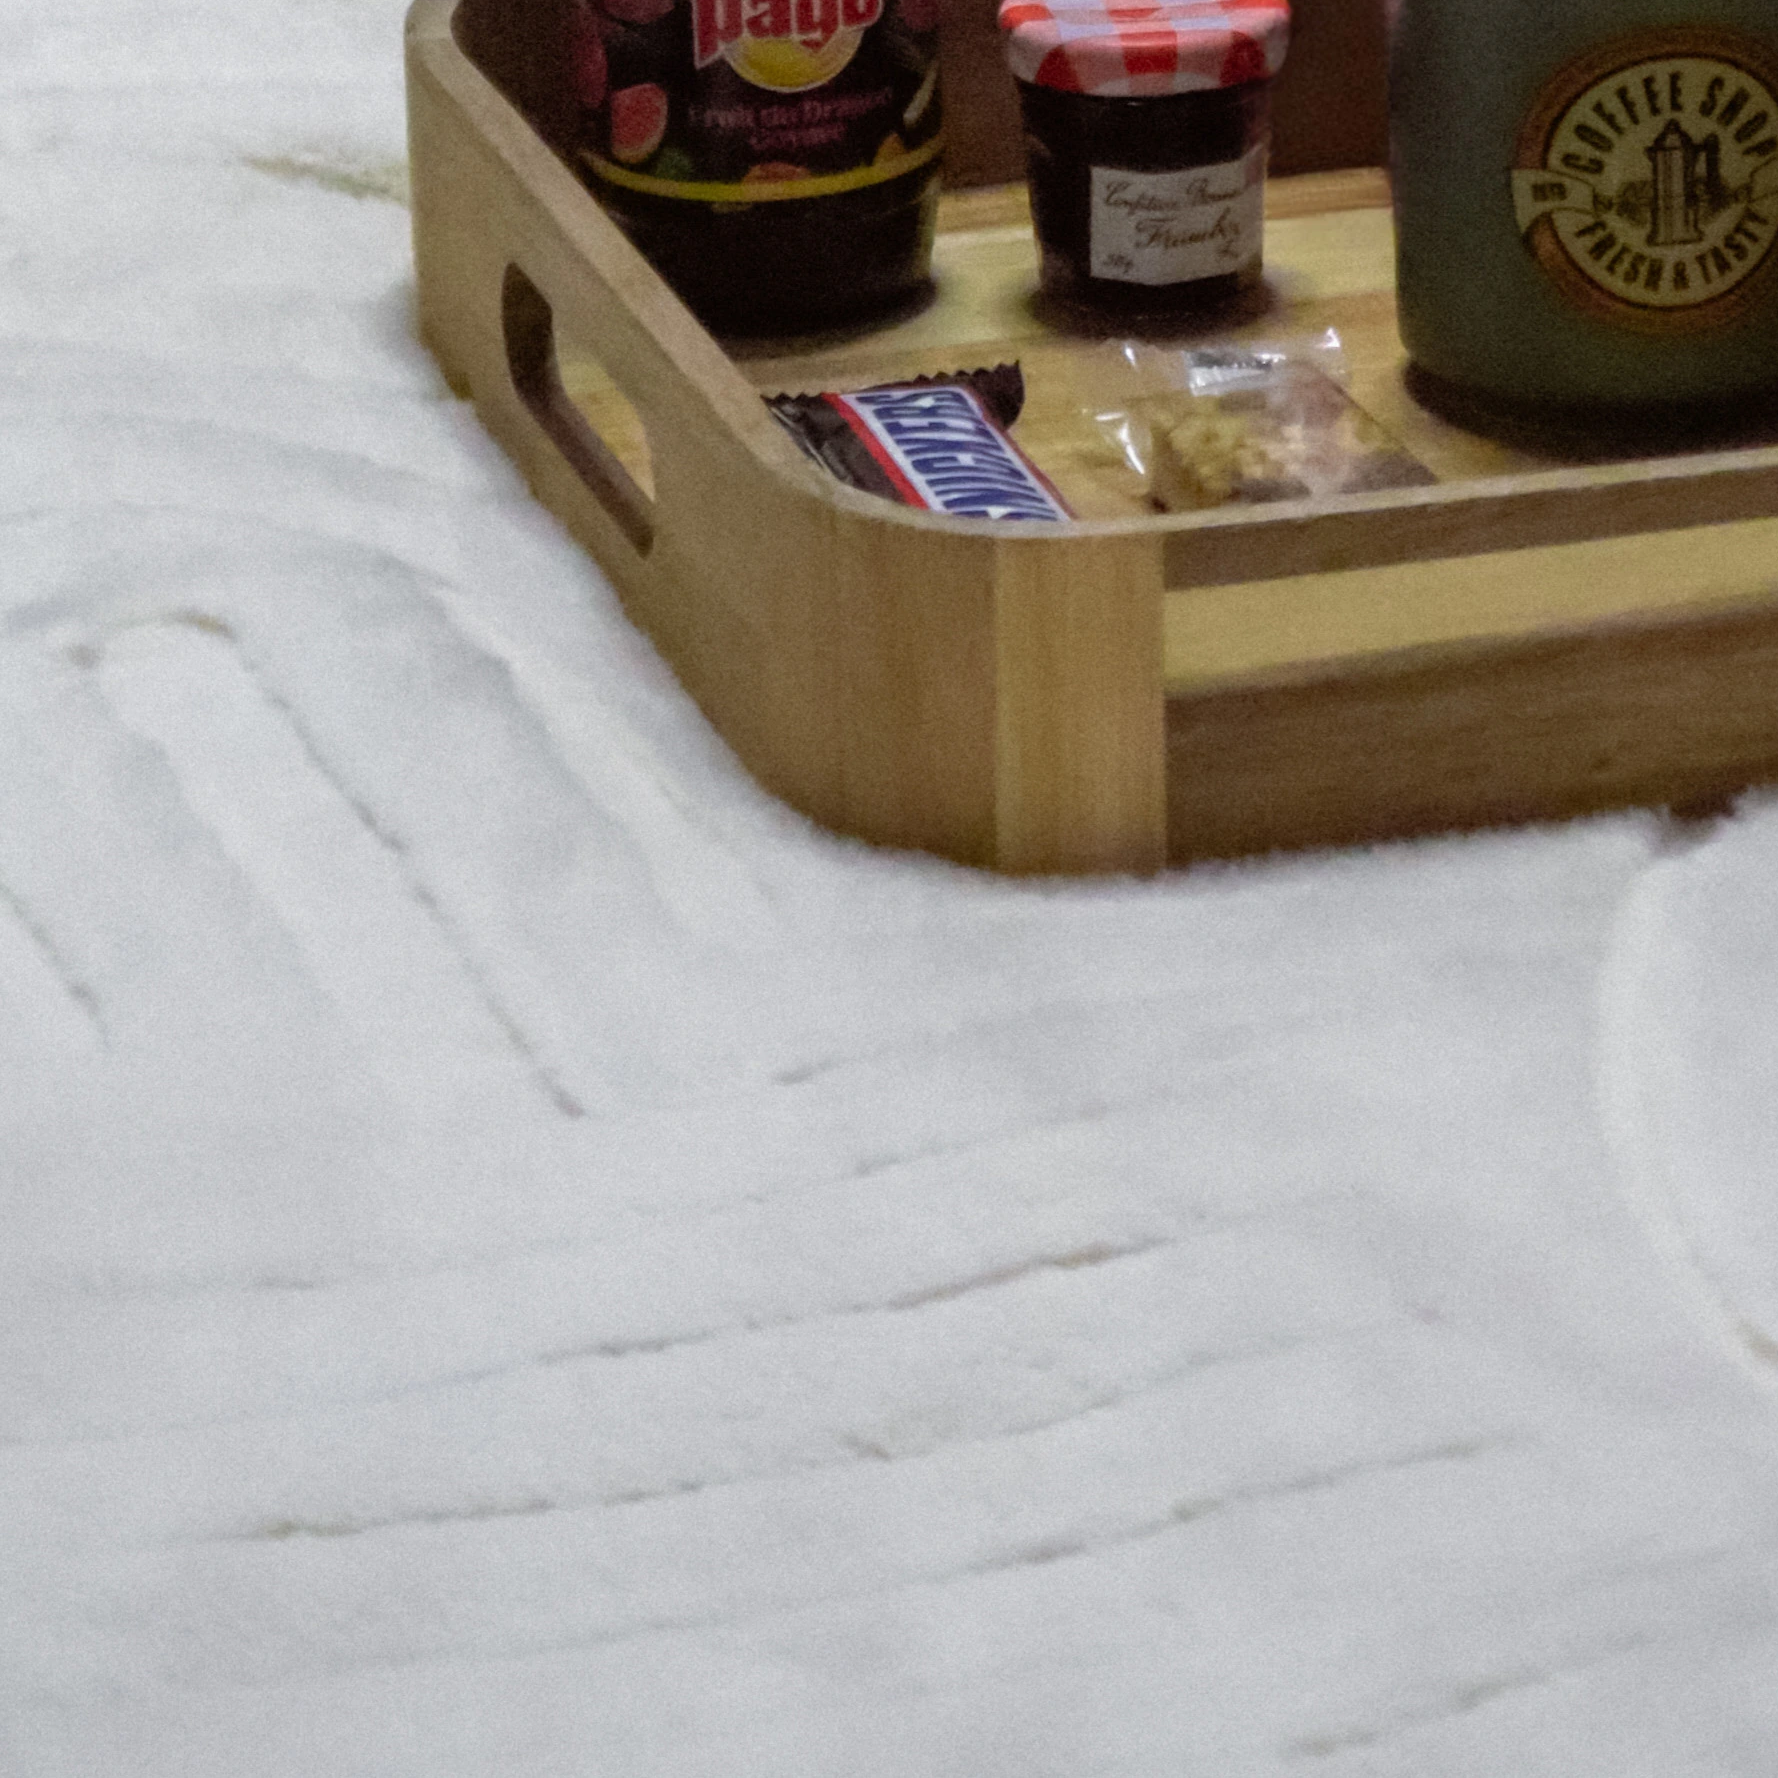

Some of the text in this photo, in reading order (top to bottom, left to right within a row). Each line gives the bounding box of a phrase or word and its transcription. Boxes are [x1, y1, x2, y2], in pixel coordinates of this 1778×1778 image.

[1560, 70, 1683, 175] COFFEE
[1573, 219, 1666, 292] FRESH
[1695, 207, 1771, 285] TASTY
